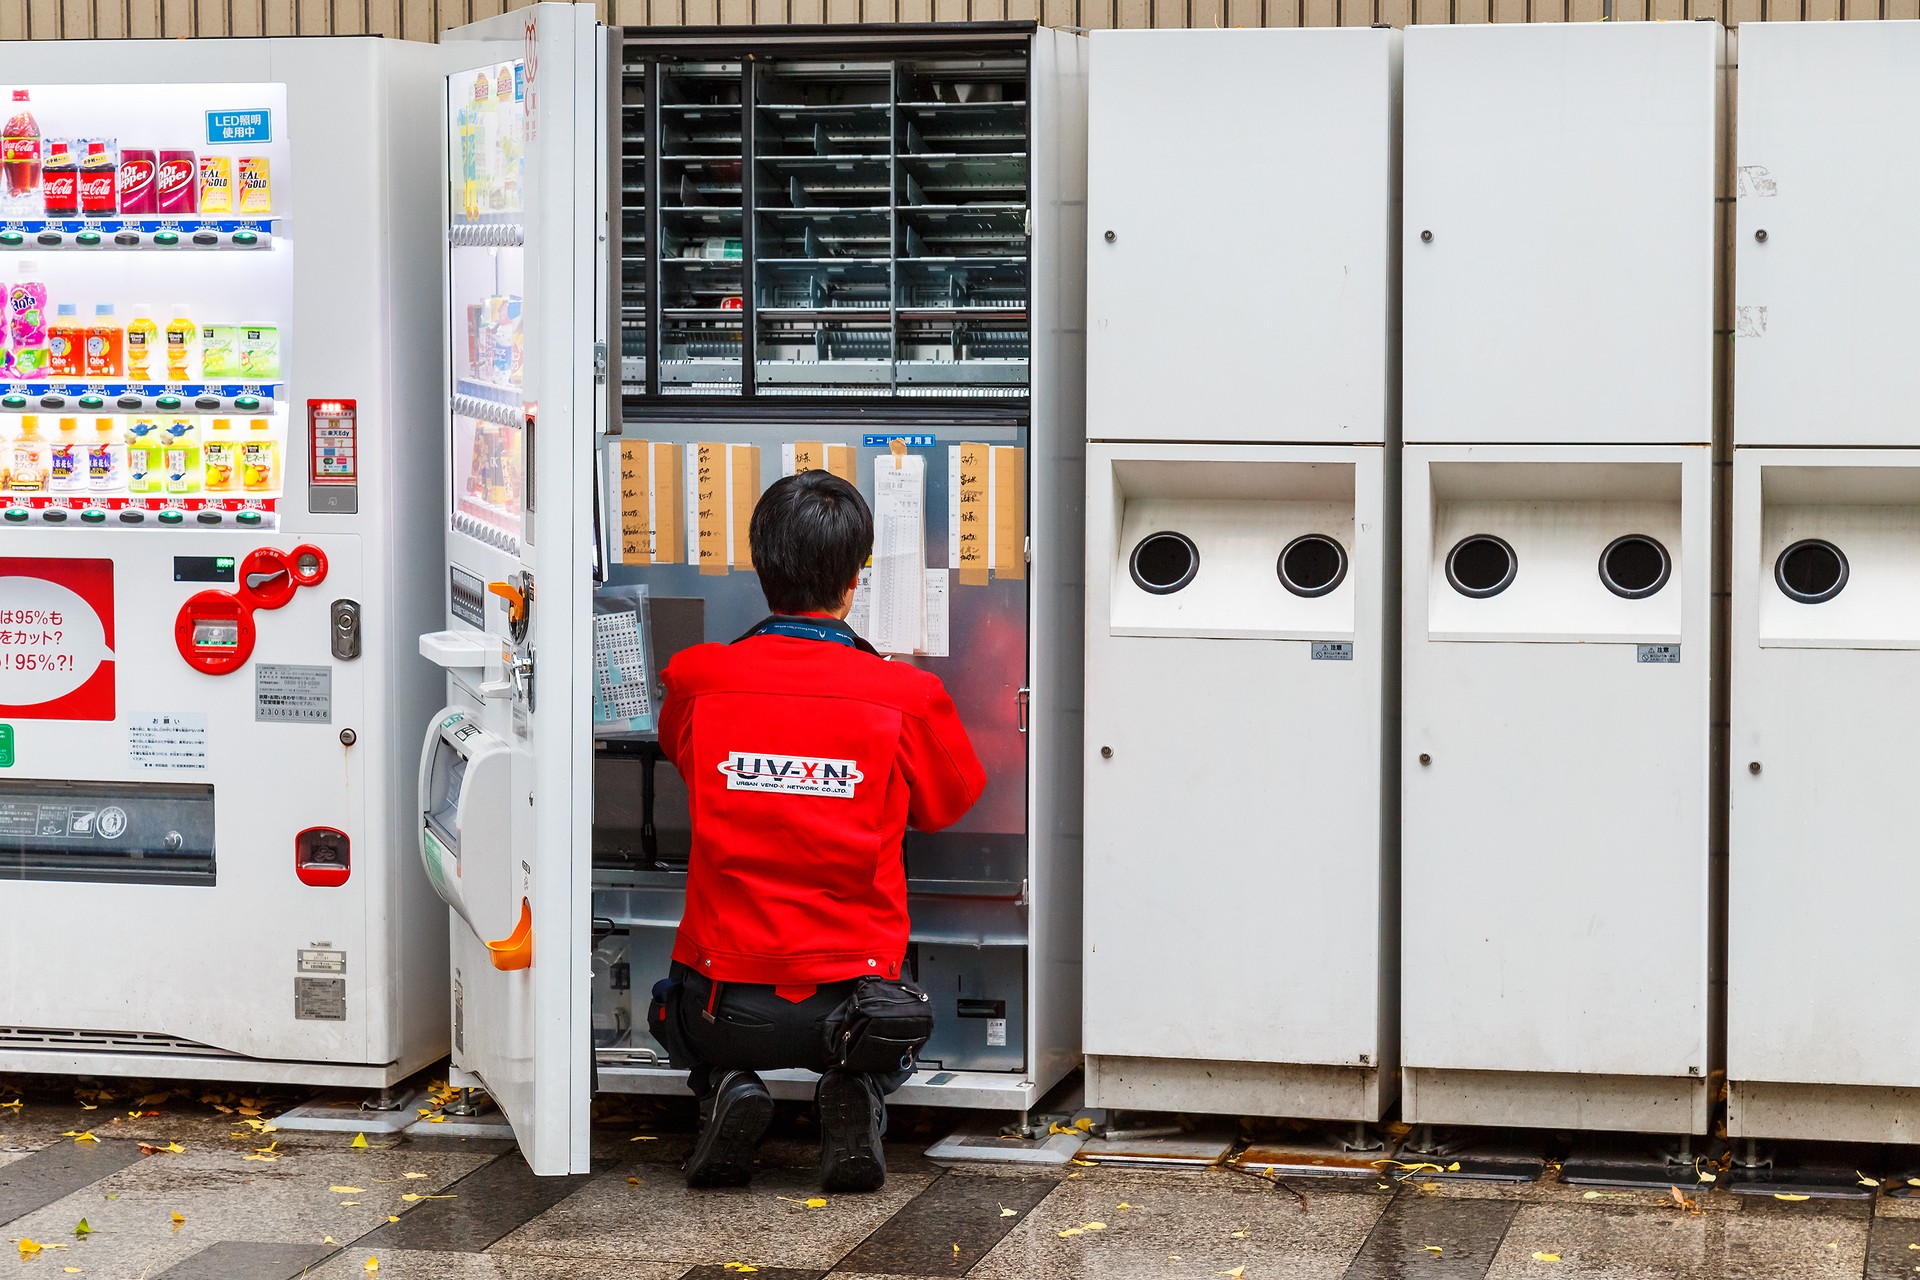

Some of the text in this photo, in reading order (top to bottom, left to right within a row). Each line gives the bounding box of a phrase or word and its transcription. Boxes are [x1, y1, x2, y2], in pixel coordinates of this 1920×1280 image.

[215, 114, 261, 127] LED照明
[222, 126, 255, 139] 使用中
[208, 178, 228, 188] GOLD
[247, 179, 267, 189] GOLD
[0, 610, 63, 626] は95%も
[737, 758, 848, 786] UV-XN
